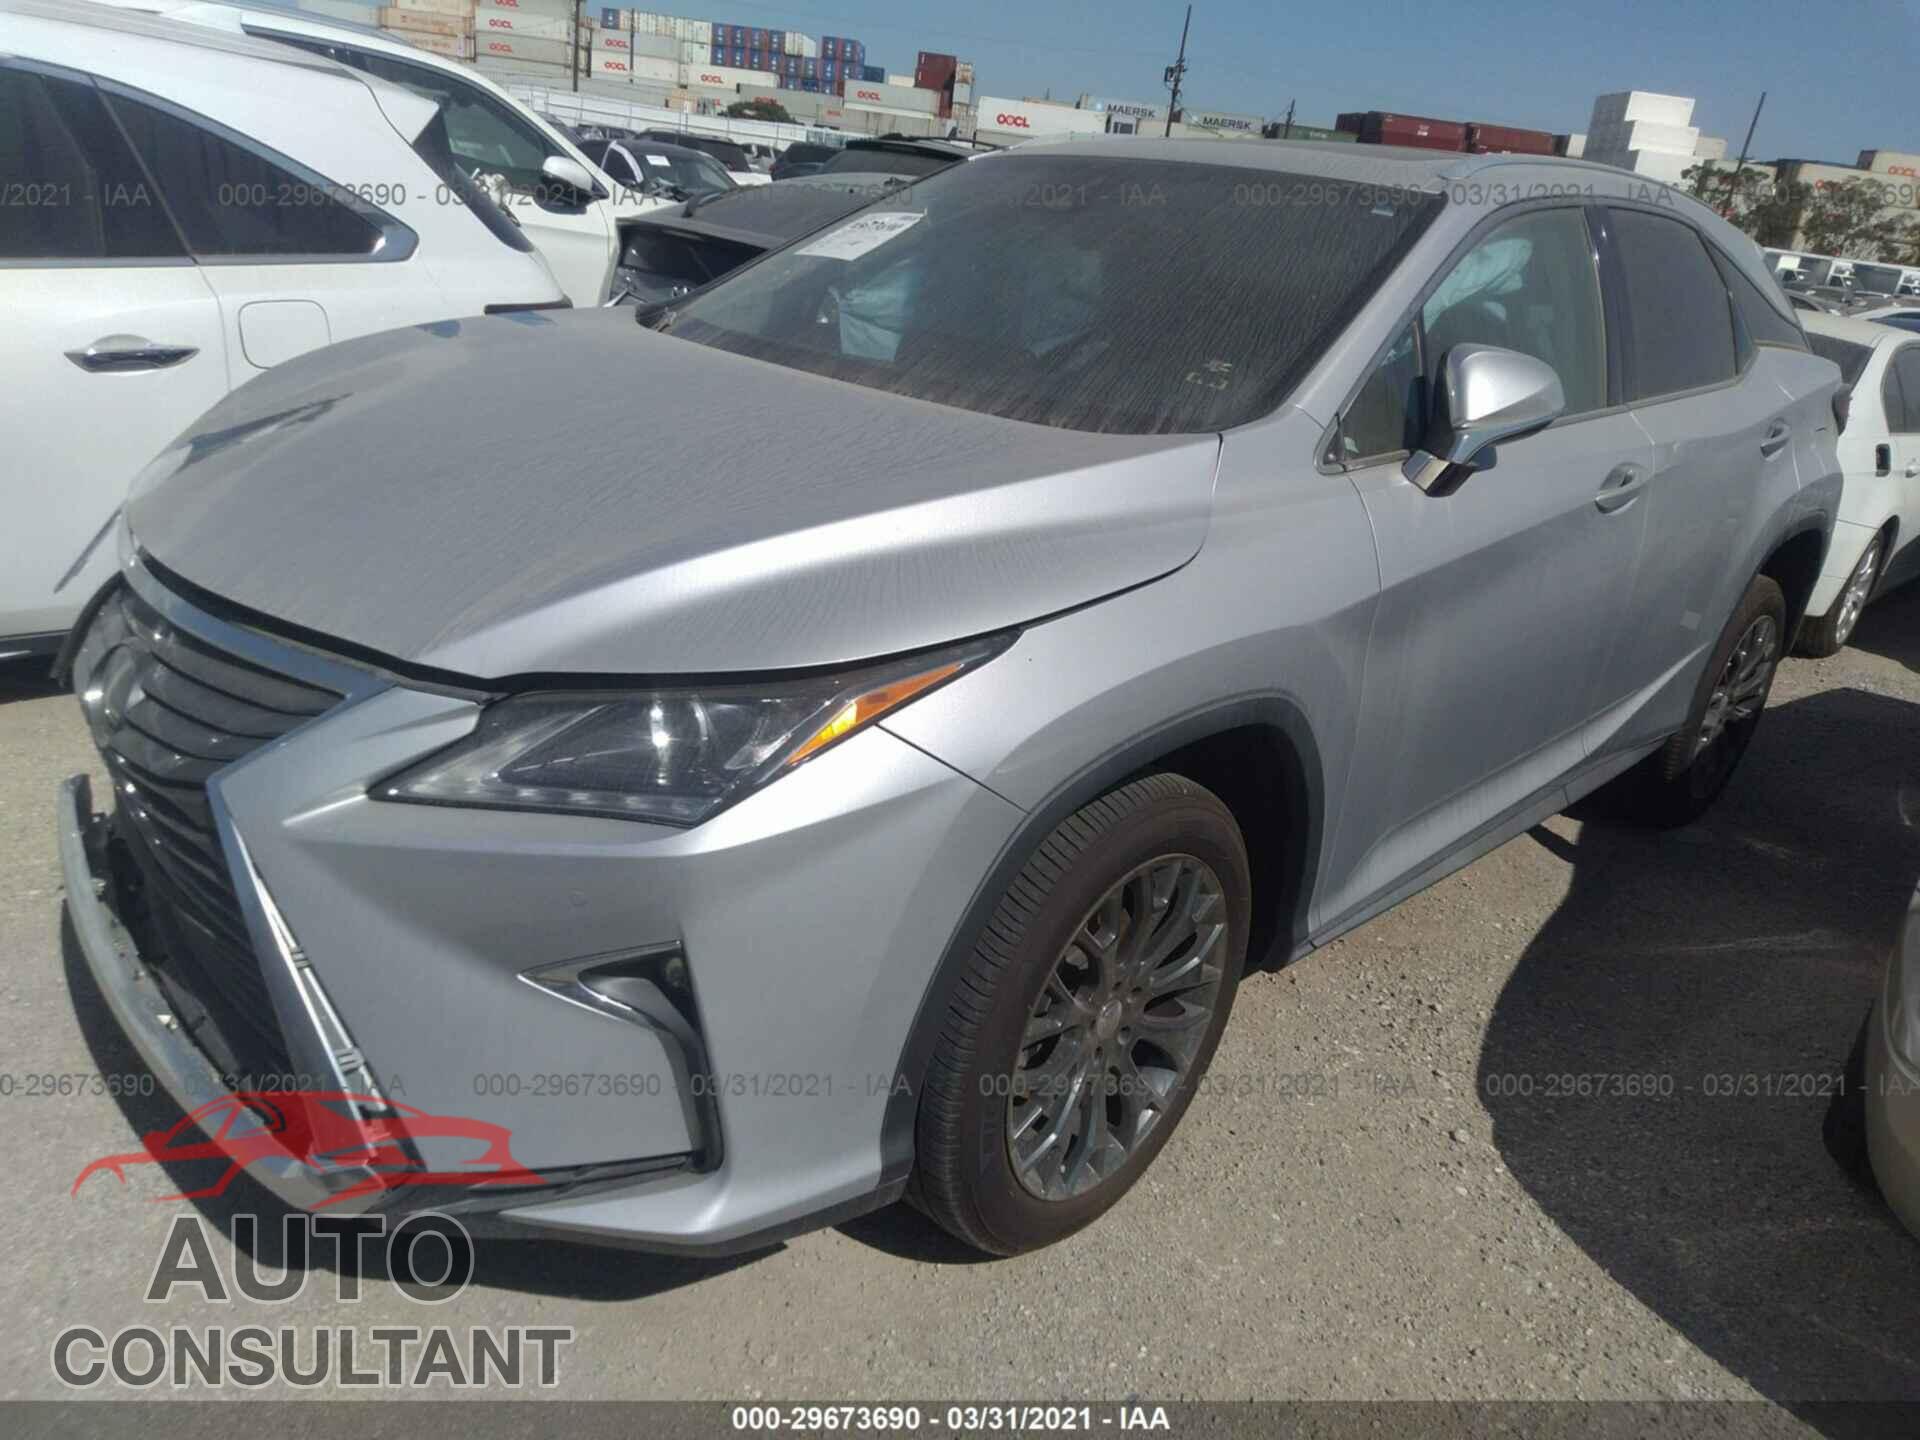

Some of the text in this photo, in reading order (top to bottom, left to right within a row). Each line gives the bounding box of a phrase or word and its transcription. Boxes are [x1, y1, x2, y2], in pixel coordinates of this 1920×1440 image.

[1107, 103, 1155, 118] MAERSK
[997, 113, 1030, 128] OOCL
[1202, 115, 1250, 130] MAERSK
